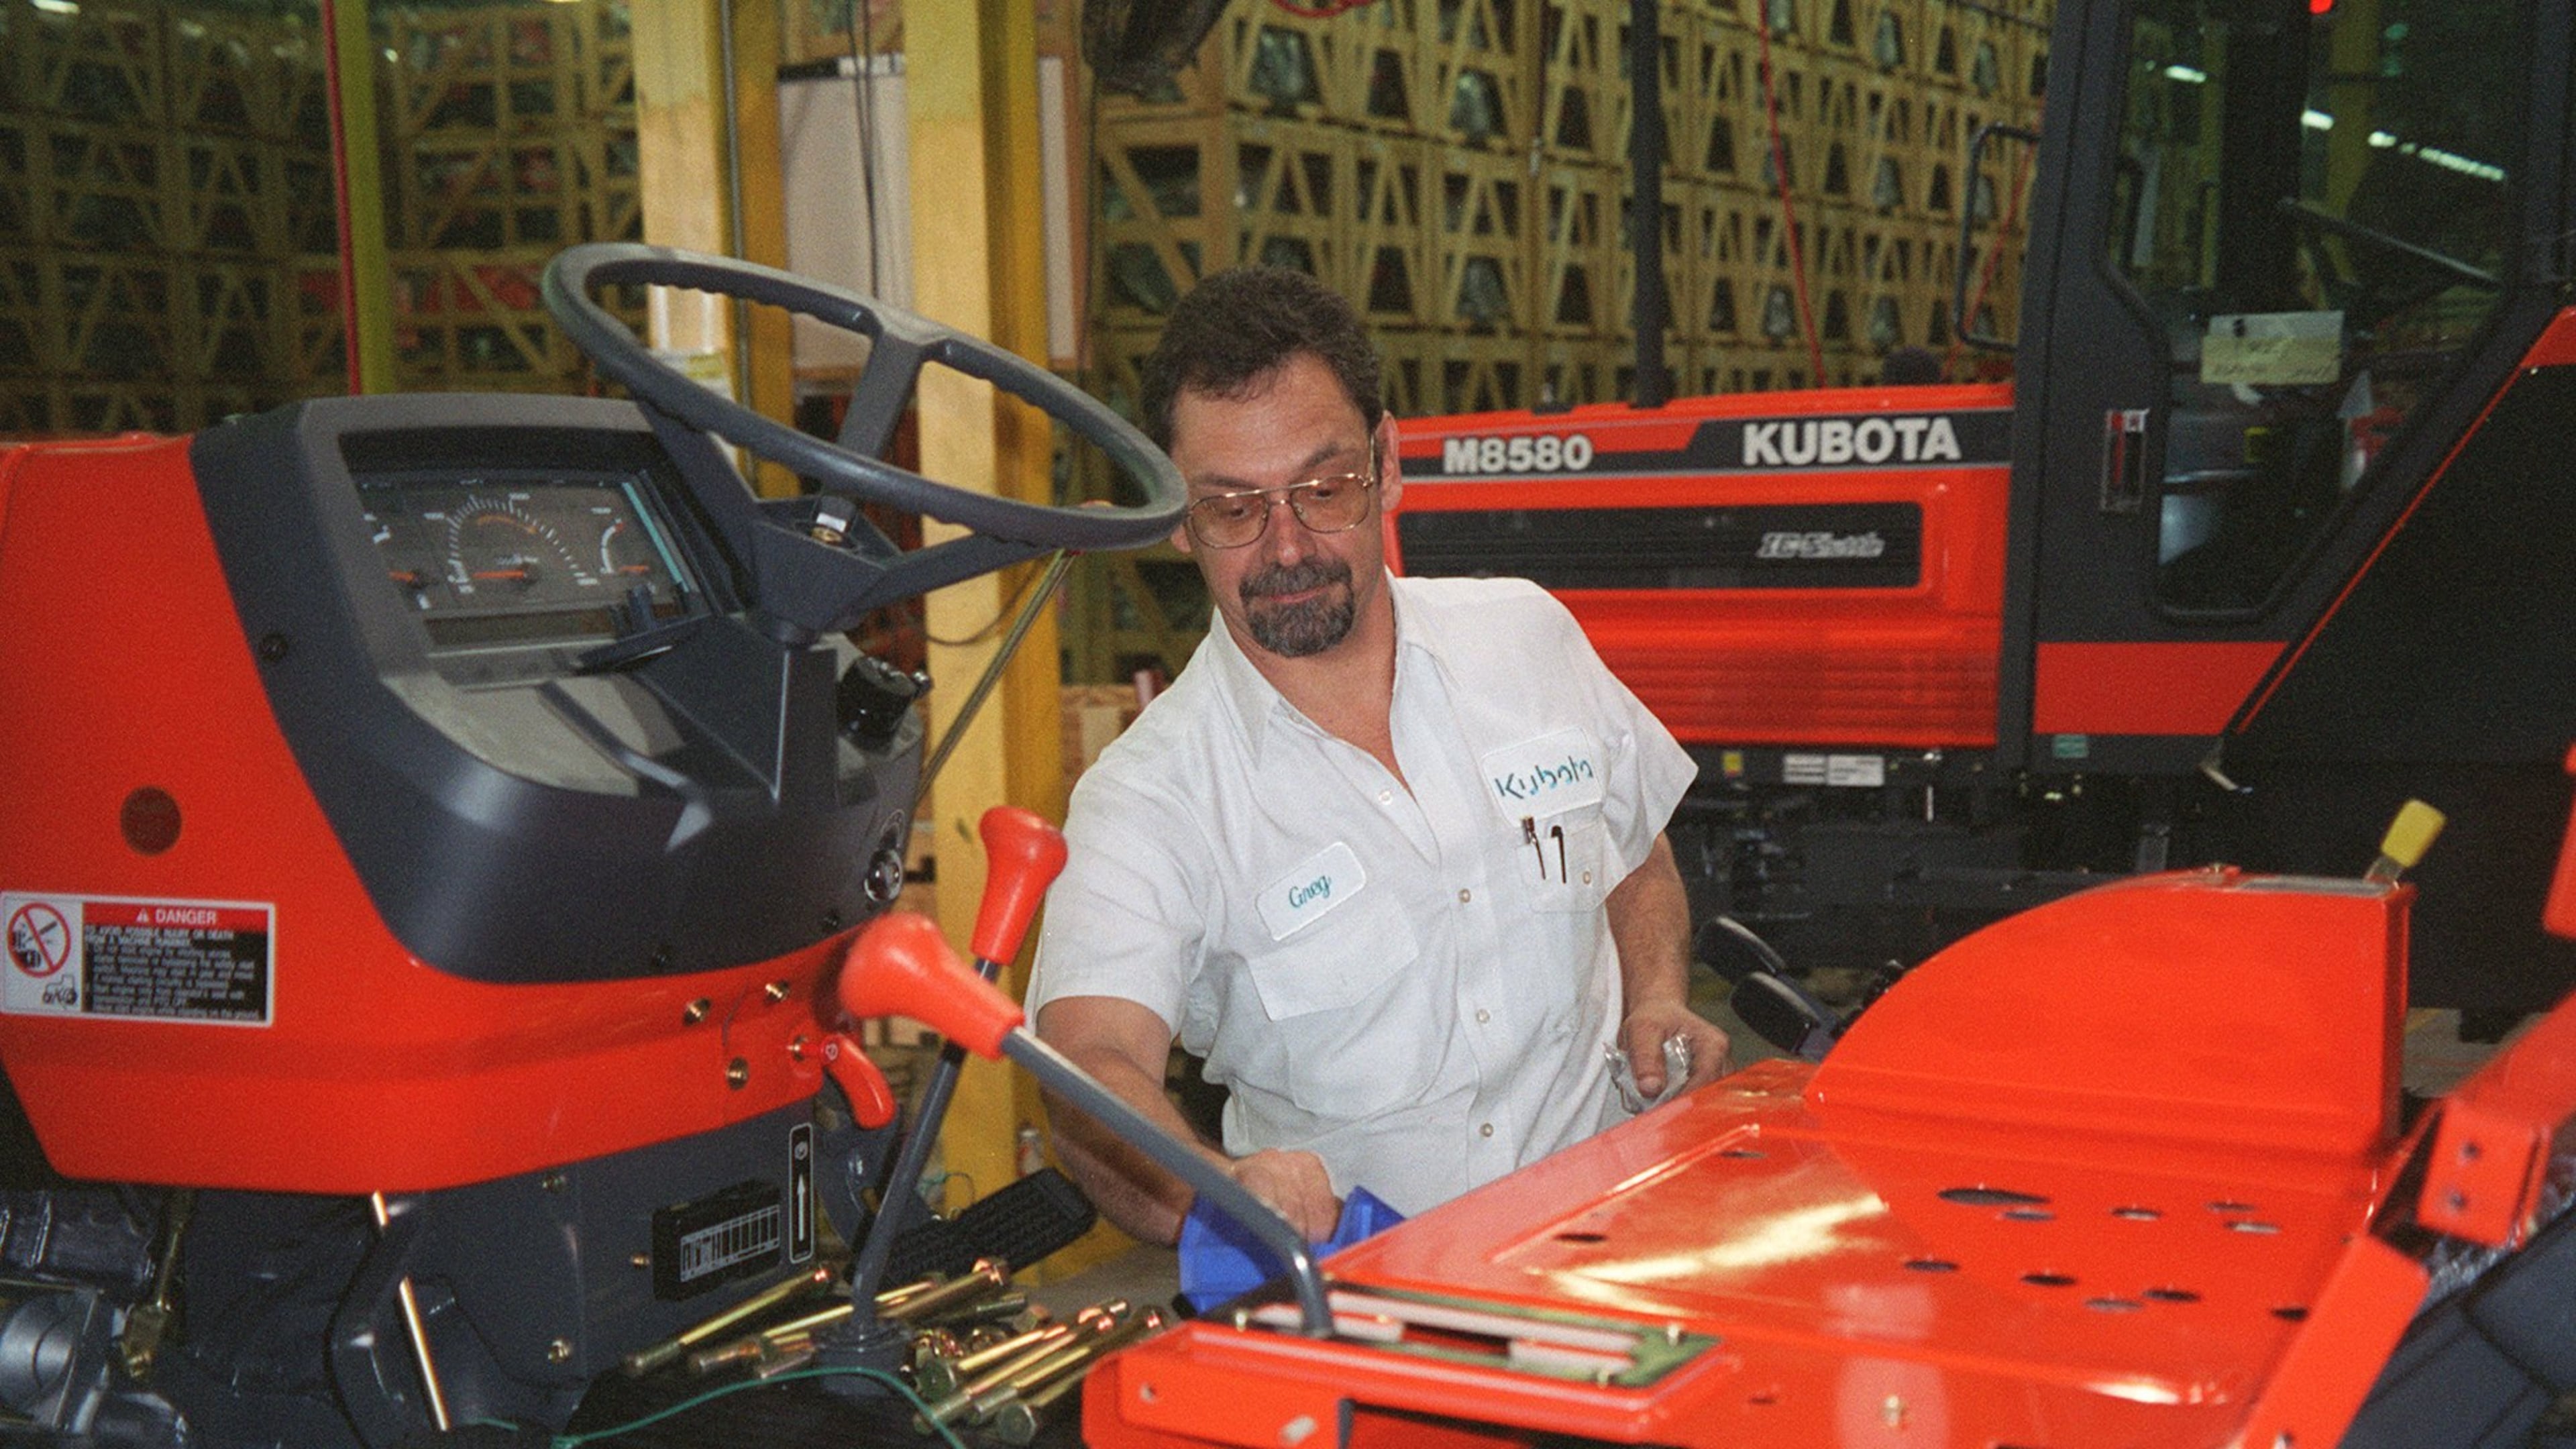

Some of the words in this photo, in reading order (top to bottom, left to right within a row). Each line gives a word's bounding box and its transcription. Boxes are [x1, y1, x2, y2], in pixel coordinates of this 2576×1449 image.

[1443, 435, 1593, 473] M8580
[1742, 417, 1962, 466] KUBOTA
[1495, 755, 1593, 800] Kubota
[1289, 875, 1332, 908] Greg
[155, 908, 217, 926] DANGER
